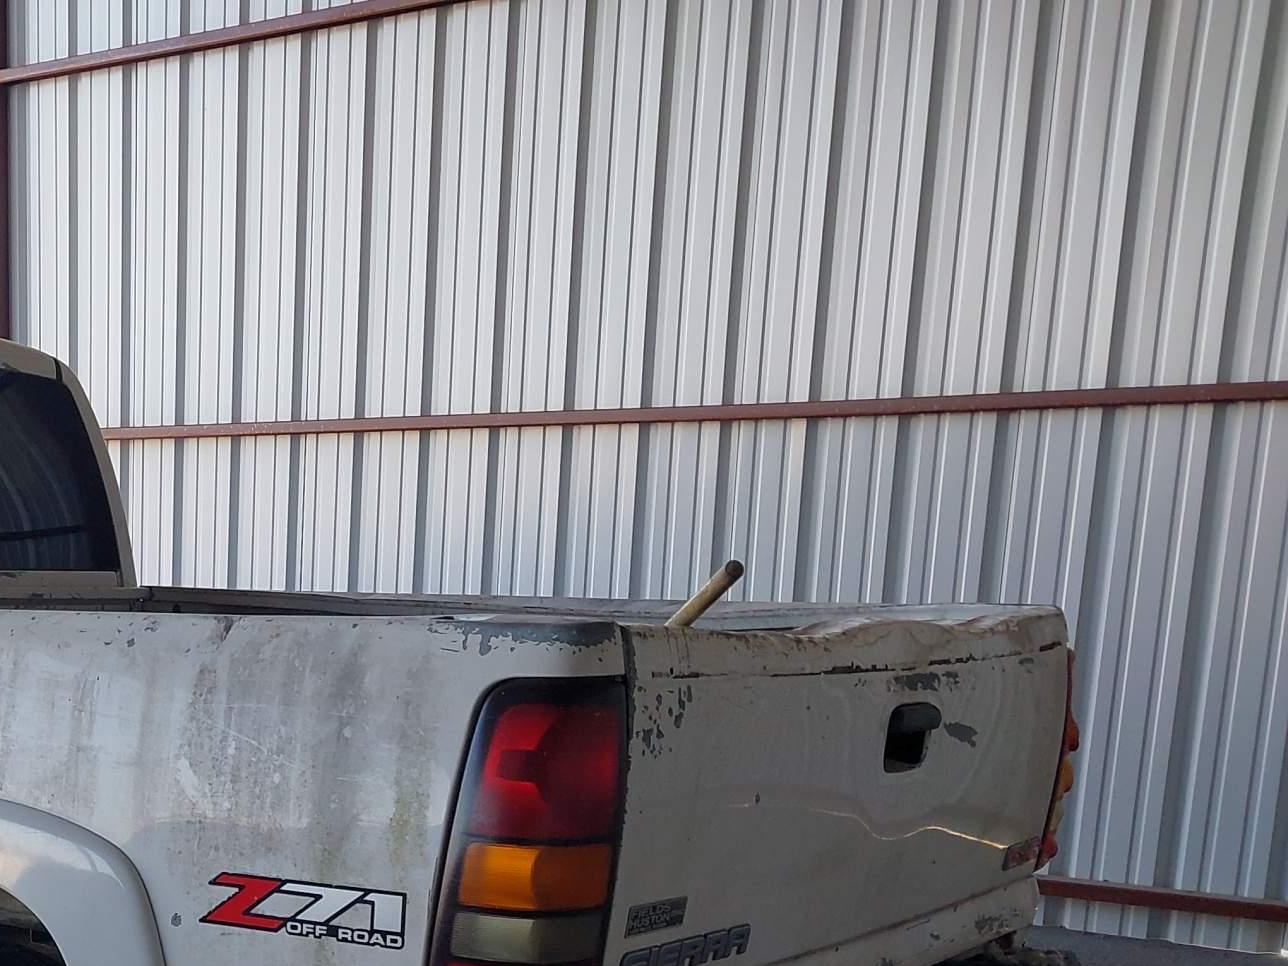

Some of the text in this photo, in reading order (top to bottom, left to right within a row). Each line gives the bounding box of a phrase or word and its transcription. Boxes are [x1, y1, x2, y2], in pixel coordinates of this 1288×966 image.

[199, 872, 407, 932] Z71
[285, 921, 403, 948] OFF ROAD
